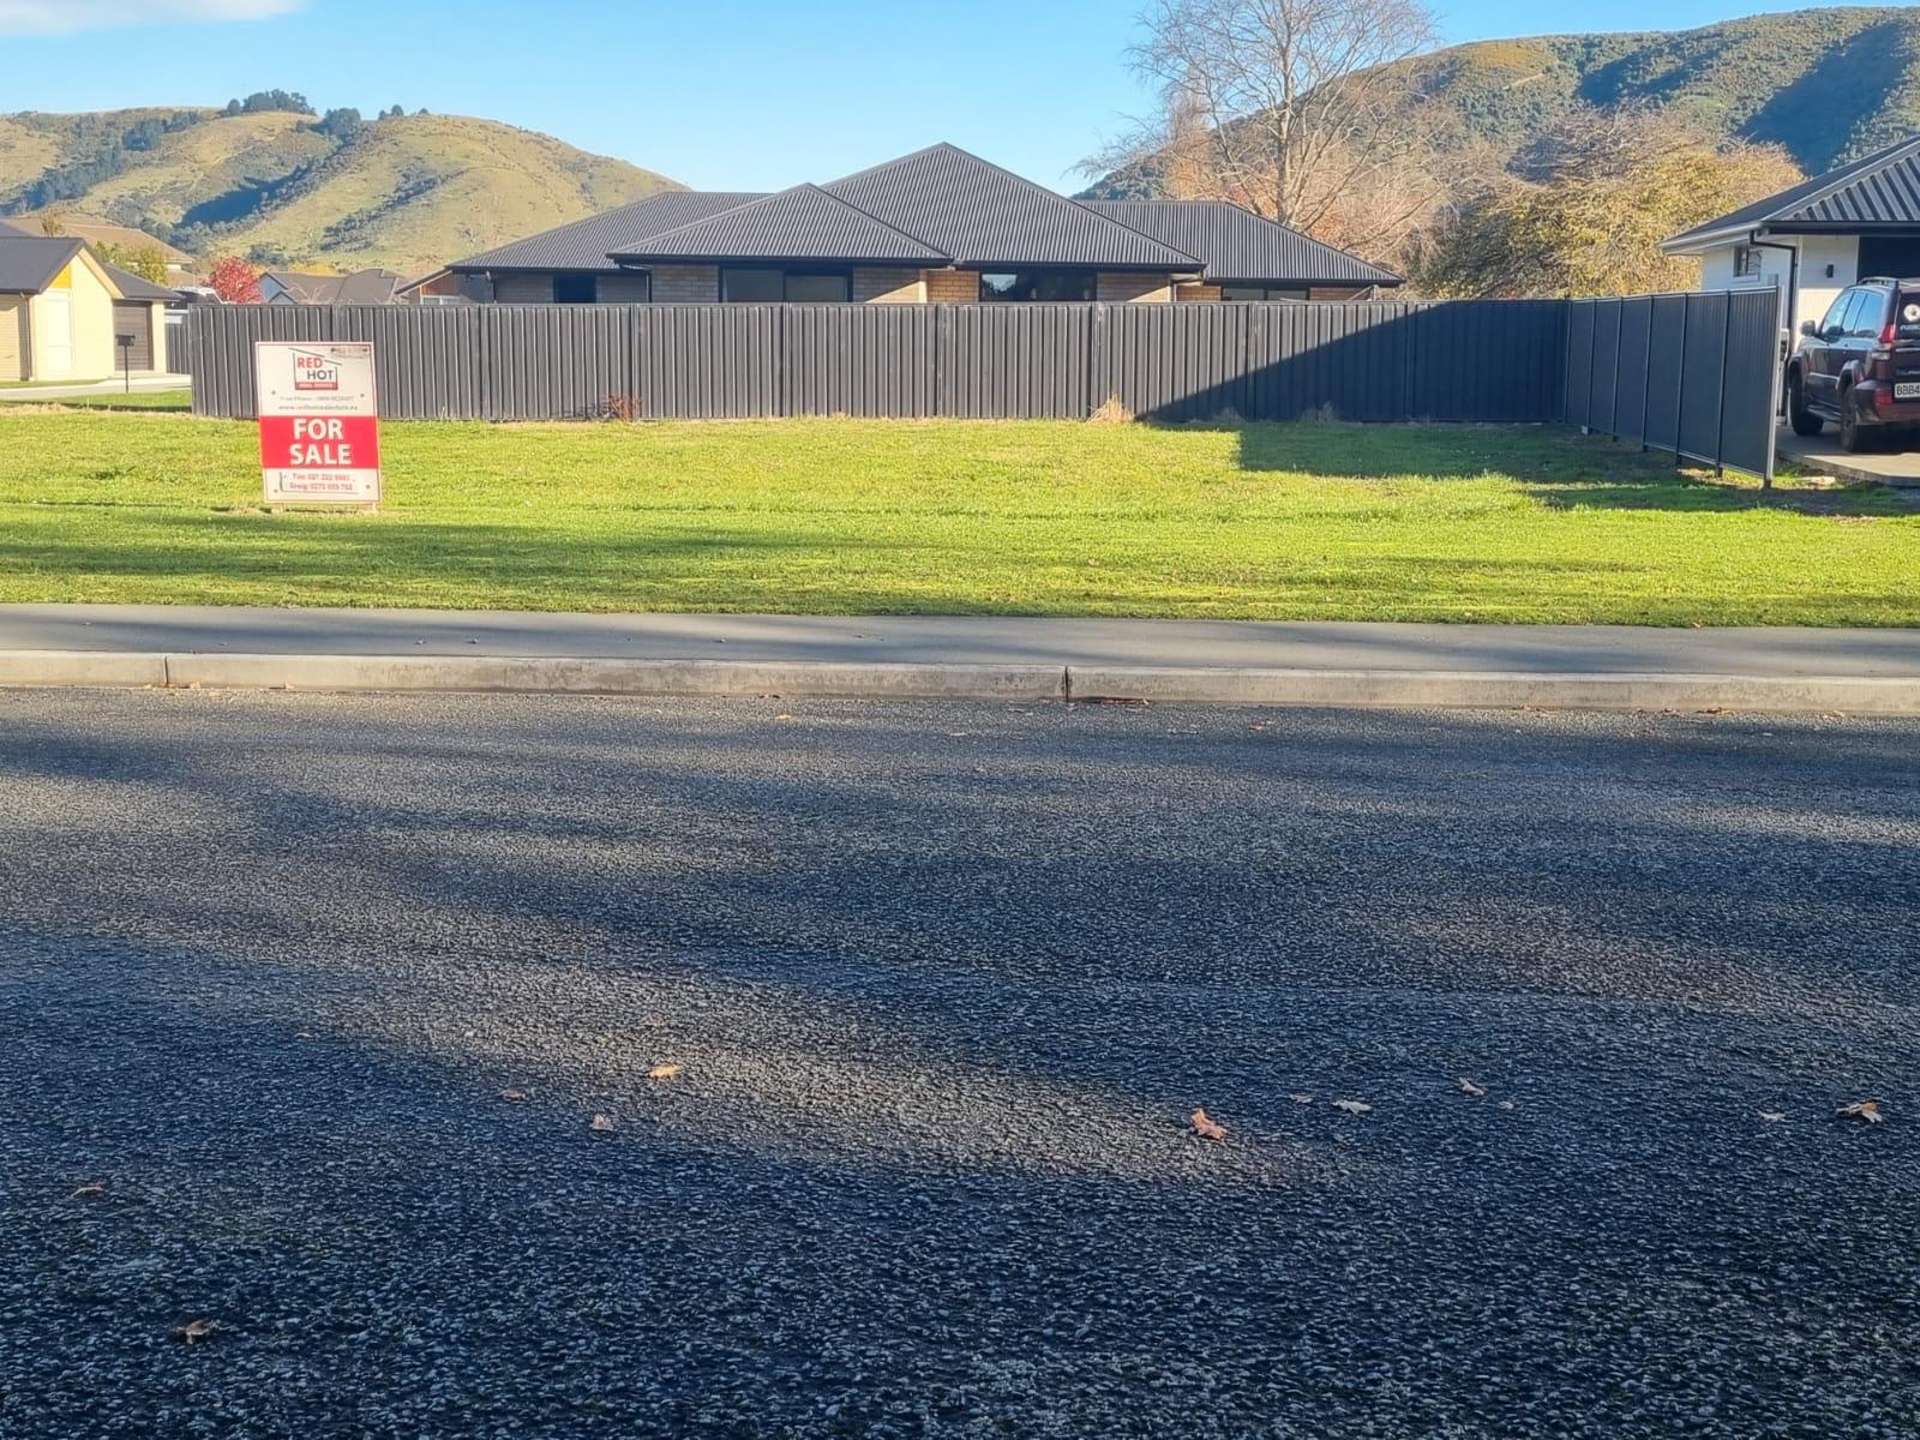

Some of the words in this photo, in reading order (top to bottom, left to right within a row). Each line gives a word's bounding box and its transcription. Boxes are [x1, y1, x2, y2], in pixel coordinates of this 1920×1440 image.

[297, 357, 323, 368] RED
[307, 370, 333, 380] HOT
[293, 418, 344, 440] FOR
[289, 444, 352, 465] SALE
